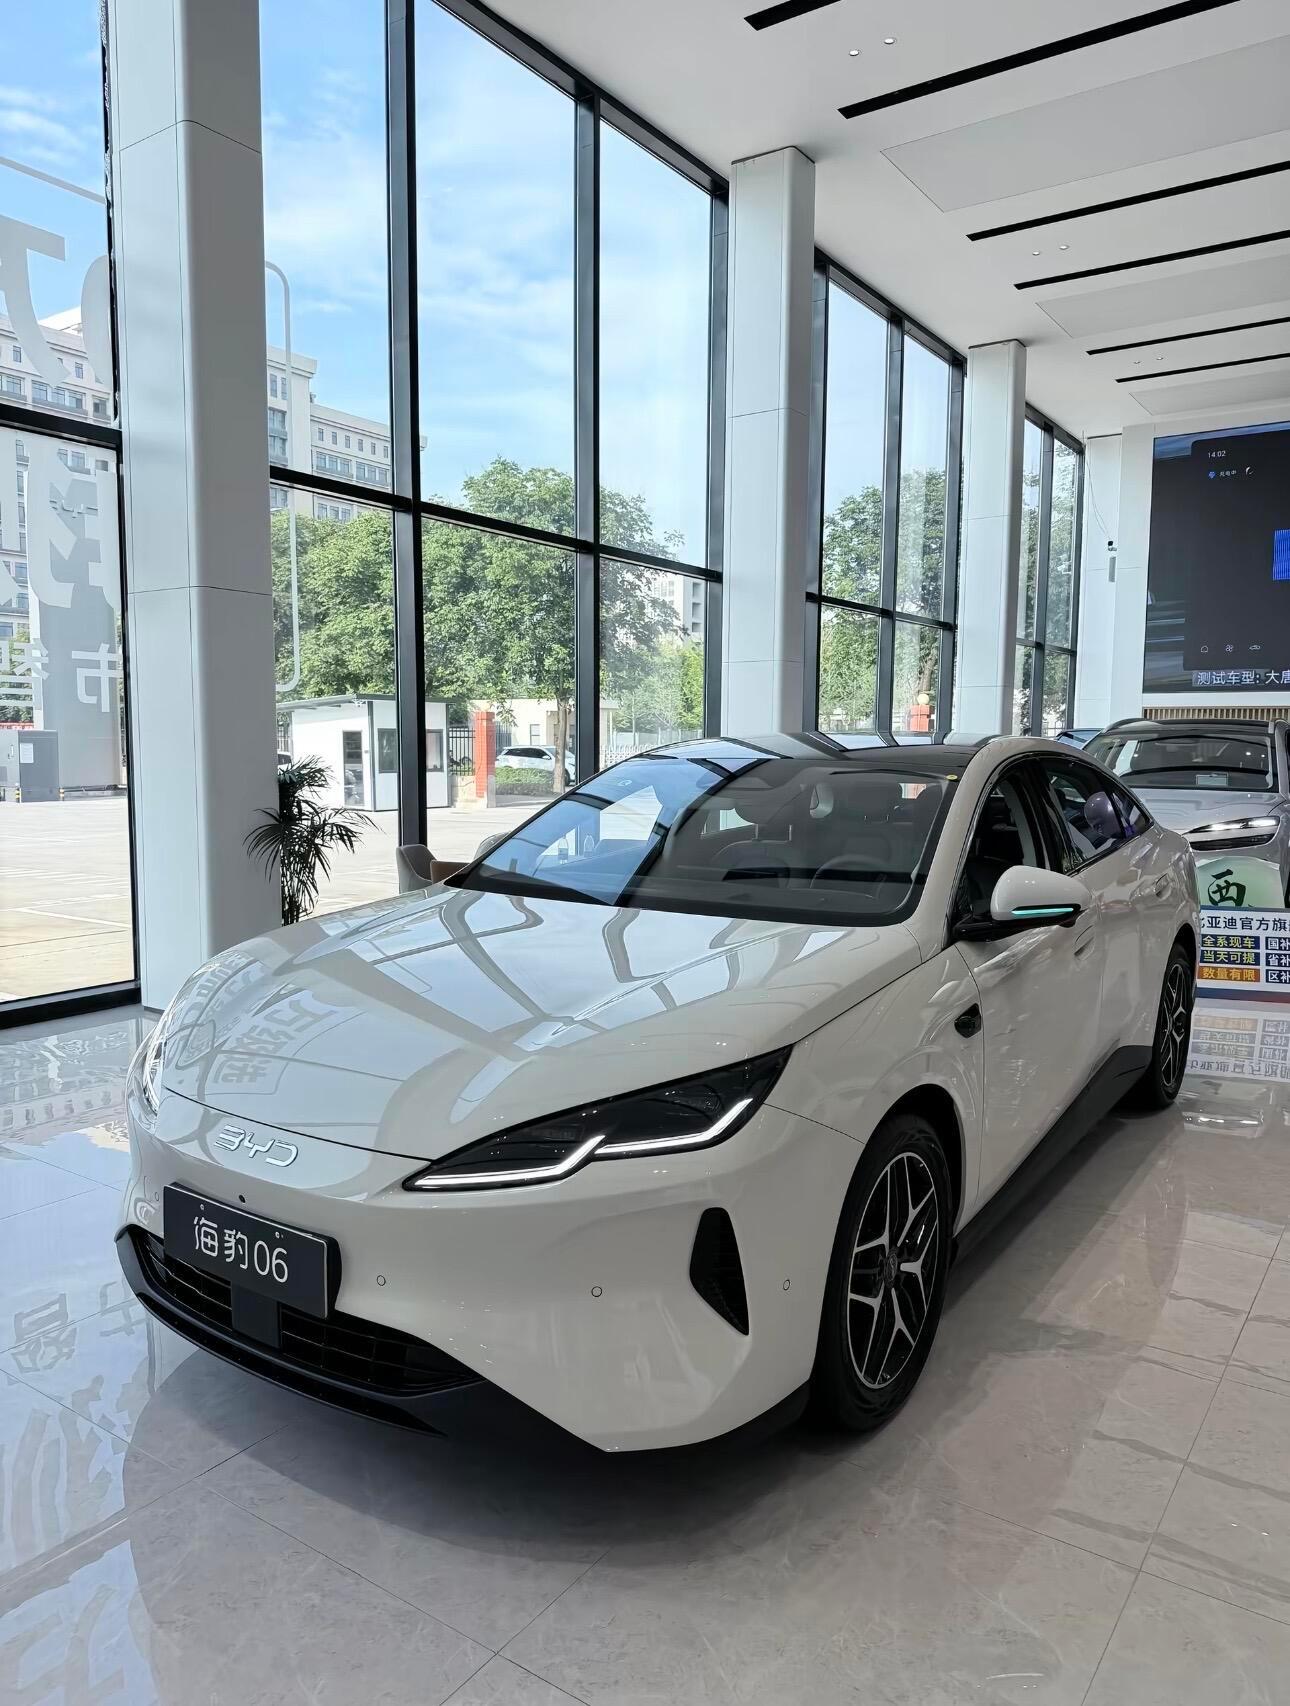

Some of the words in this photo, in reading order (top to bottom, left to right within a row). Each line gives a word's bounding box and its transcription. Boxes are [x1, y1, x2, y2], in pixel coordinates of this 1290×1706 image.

[1208, 868, 1246, 907] 西
[1202, 935, 1256, 949] 全系现车
[1203, 950, 1256, 964] 当天可提
[1202, 967, 1256, 981] 数量有限
[214, 1124, 299, 1168] BYD
[193, 1216, 289, 1283] 海豹06
